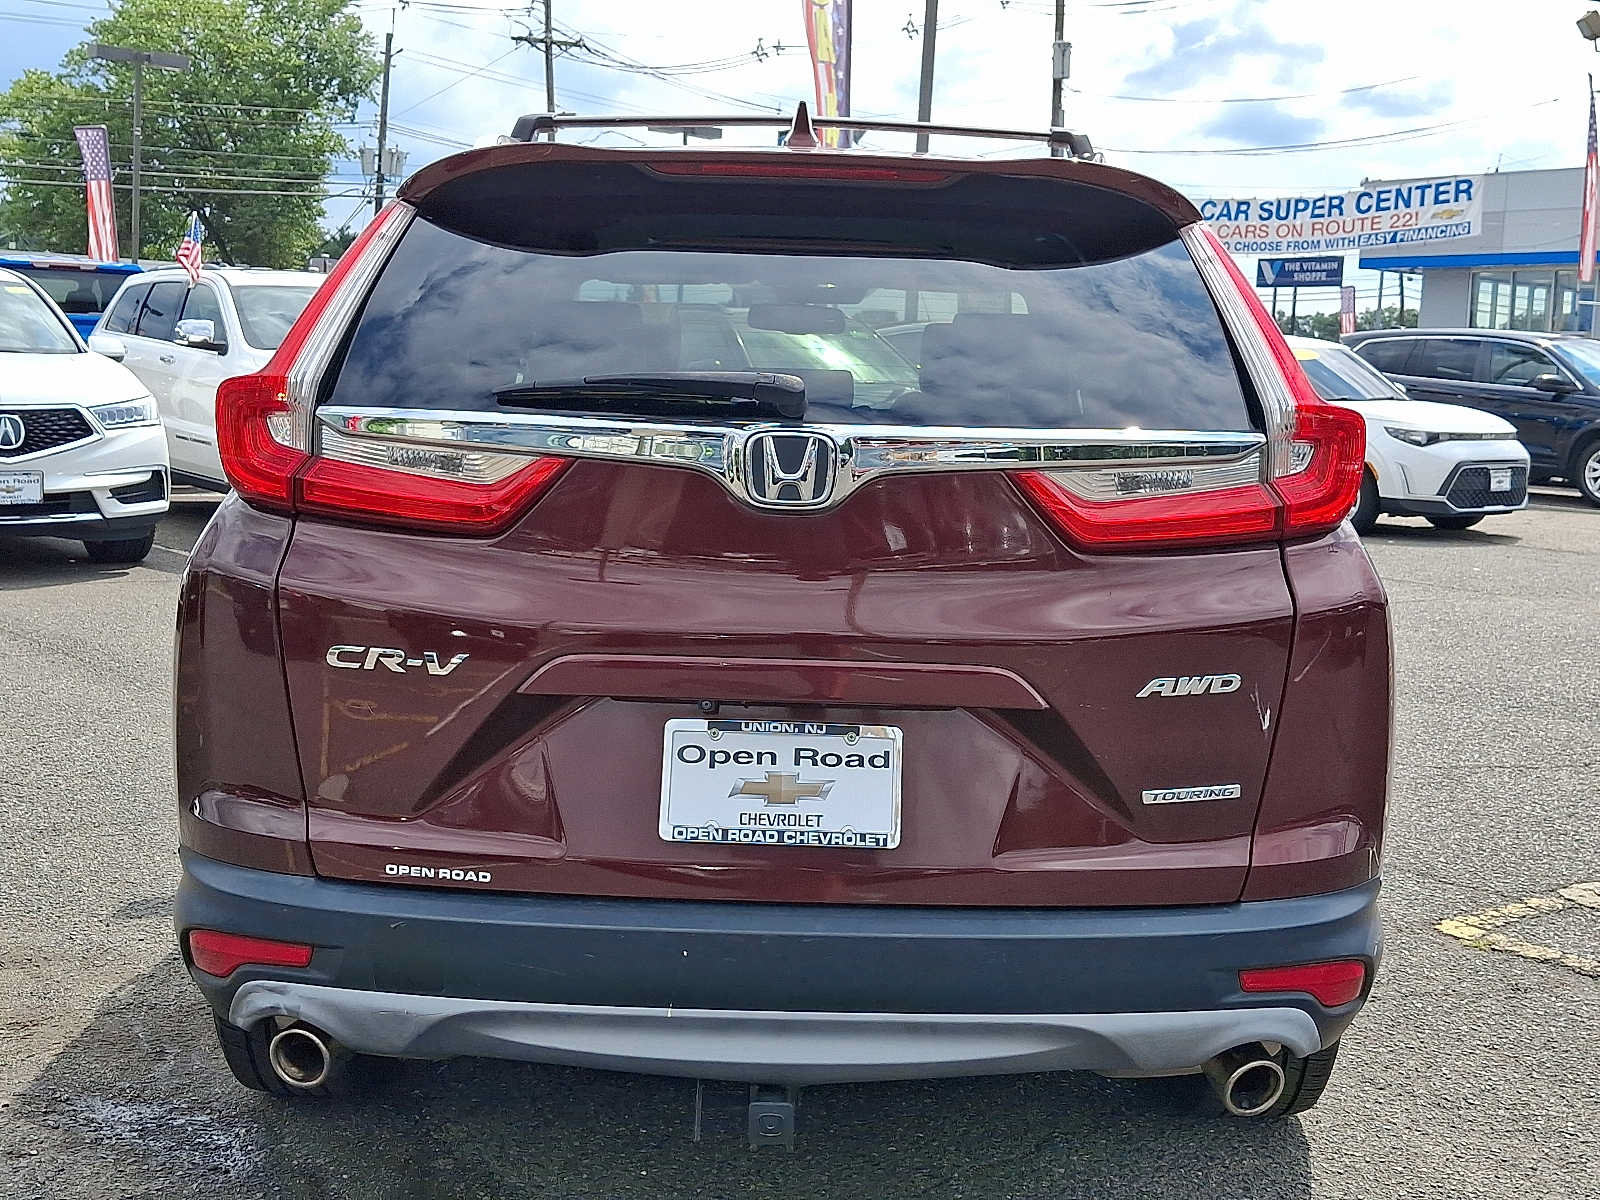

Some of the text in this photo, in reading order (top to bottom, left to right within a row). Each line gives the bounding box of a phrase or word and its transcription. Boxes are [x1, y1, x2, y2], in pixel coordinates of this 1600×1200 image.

[1201, 179, 1473, 221] CAR SUPER CENTER
[1217, 211, 1419, 239] CARS ON ROUTE 22!
[1234, 240, 1283, 251] CHOOSE
[1287, 239, 1320, 251] FROM
[1325, 236, 1356, 248] WITH
[1360, 231, 1395, 246] EASY
[1396, 222, 1469, 243] FINANCING
[1284, 261, 1339, 272] THE VITAMIN
[1293, 271, 1328, 281] SHOPPE
[326, 644, 470, 676] CR-V
[1136, 673, 1242, 698] AWD
[741, 721, 827, 734] UNION, NJ
[677, 744, 891, 769] Open Road
[1148, 787, 1236, 802] TOURING
[739, 812, 824, 828] CHEVROLET
[673, 826, 887, 847] OPEN ROAD CHEVROLET
[385, 863, 492, 883] OPEN ROAD
